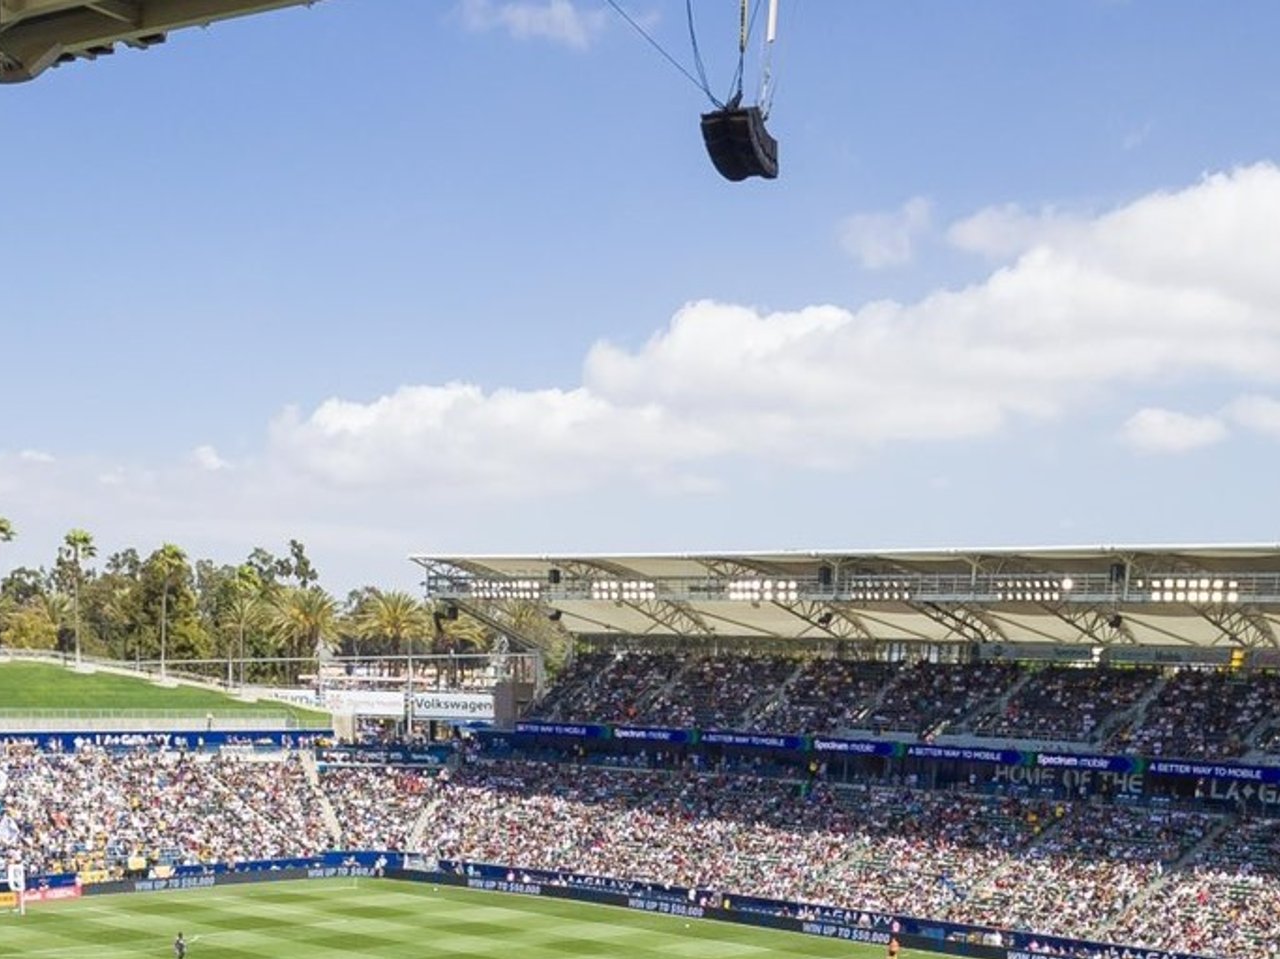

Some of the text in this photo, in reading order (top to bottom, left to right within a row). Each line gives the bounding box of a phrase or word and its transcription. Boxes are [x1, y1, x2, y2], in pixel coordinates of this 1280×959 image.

[416, 698, 492, 712] Volkswagen
[614, 728, 647, 738] Spectrum
[814, 740, 849, 751] Spectrum
[915, 748, 943, 758] BETTER
[944, 749, 960, 759] WAY
[962, 751, 972, 759] TO
[974, 751, 1001, 762] MOBILE
[1037, 754, 1110, 769] Spectrum mobile
[1149, 763, 1261, 779] A BETTER WAY TO MOBILE
[1098, 772, 1143, 794] THE
[1210, 778, 1241, 800] LA
[628, 898, 644, 908] WIN
[646, 900, 657, 910] UP
[659, 901, 670, 911] TO
[802, 922, 821, 933] WIN
[823, 924, 837, 936] UP
[838, 926, 850, 938] TO
